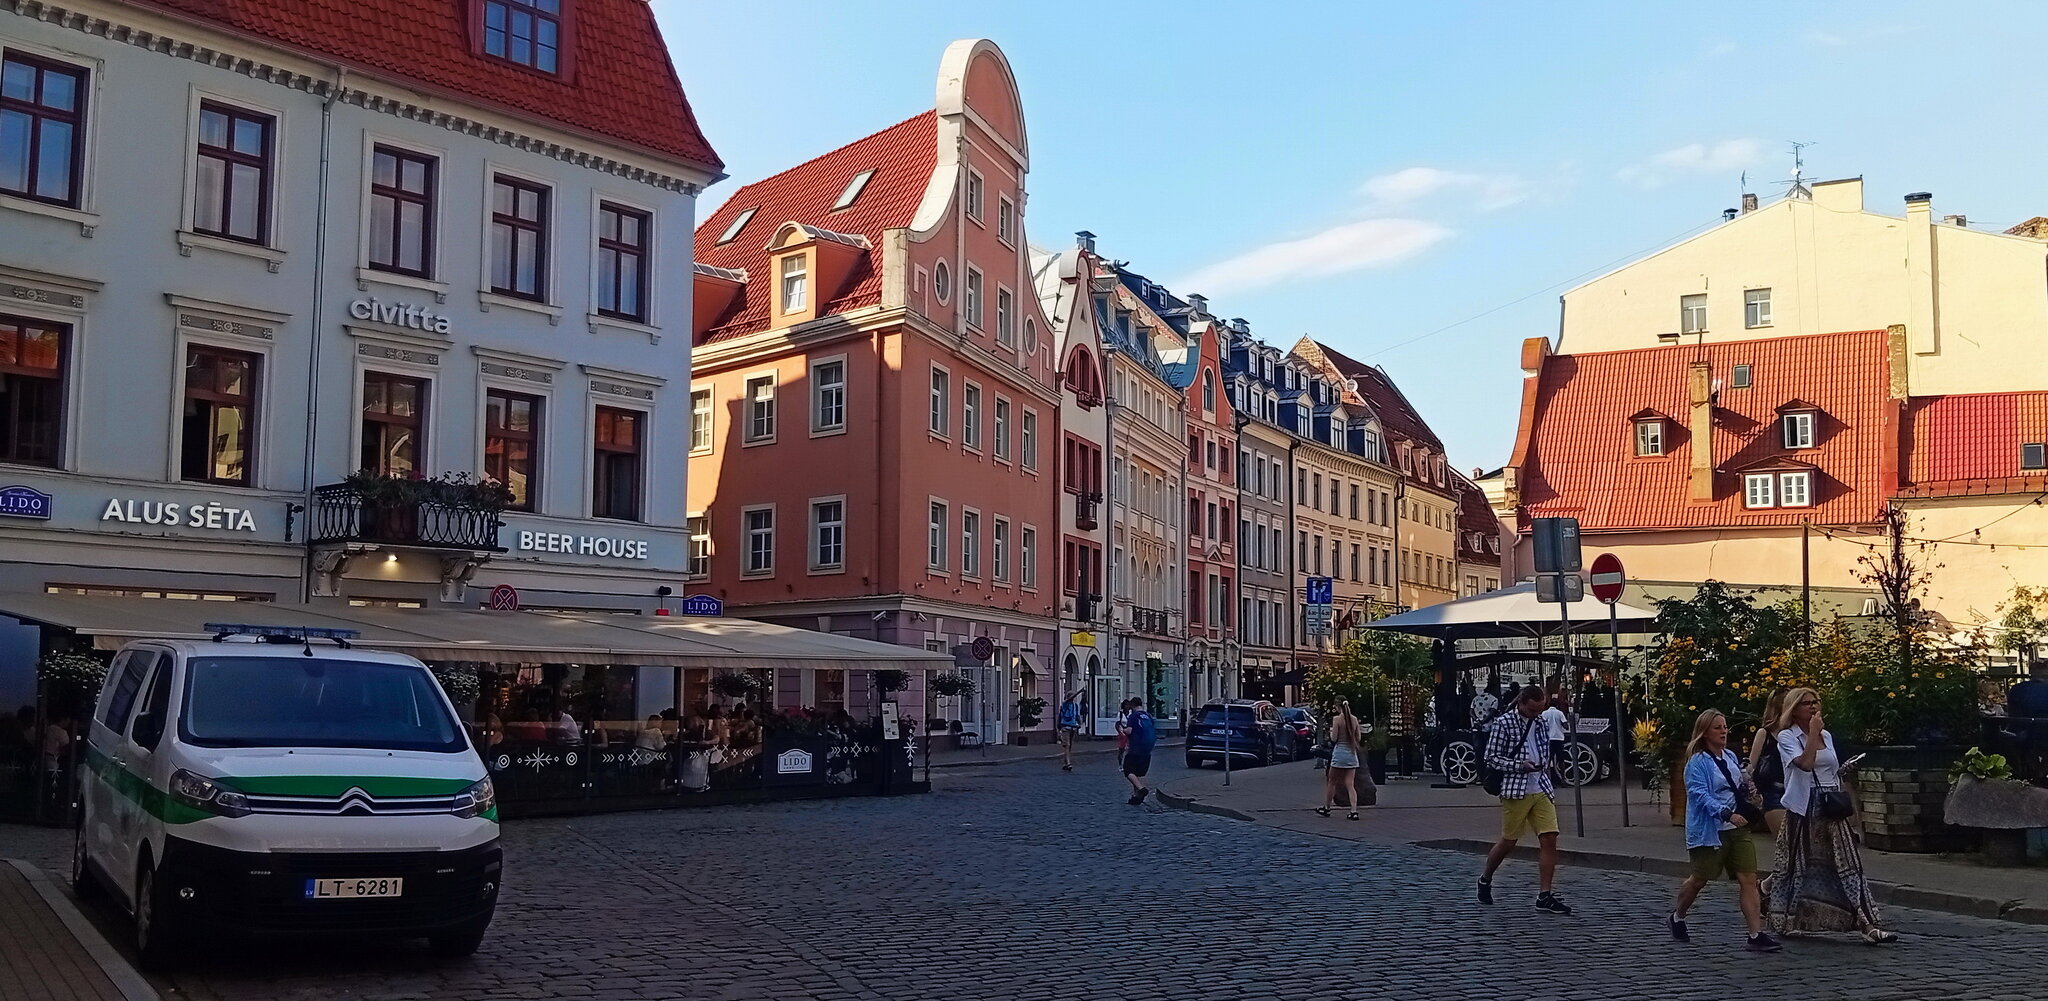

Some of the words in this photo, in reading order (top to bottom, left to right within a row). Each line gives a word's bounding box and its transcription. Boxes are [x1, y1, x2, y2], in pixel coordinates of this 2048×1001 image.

[350, 299, 450, 335] civitta
[0, 496, 41, 510] LIDO
[102, 498, 181, 526] ALUS
[189, 502, 257, 532] SĒTA
[520, 531, 573, 555] BEER
[580, 536, 648, 559] HOUSE
[688, 602, 718, 611] LIDO
[783, 757, 807, 767] LIDO
[318, 879, 399, 897] LT-6281
